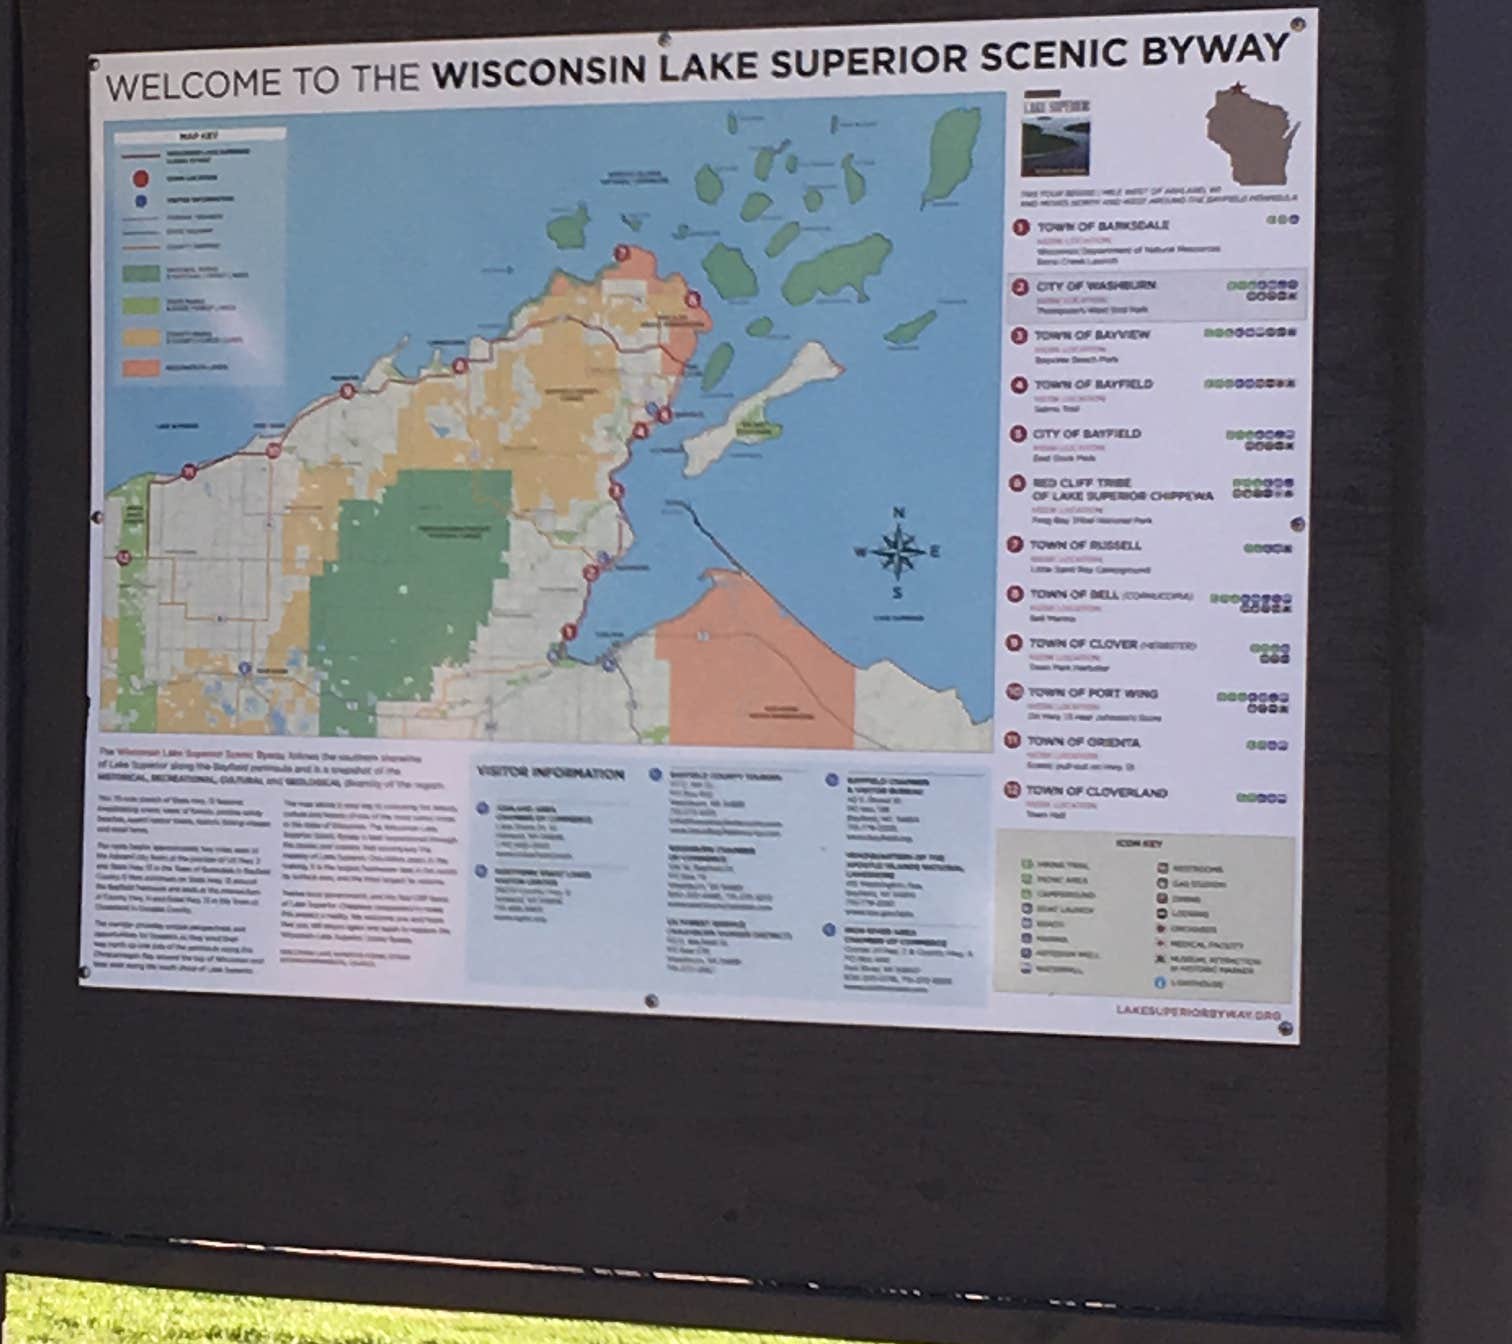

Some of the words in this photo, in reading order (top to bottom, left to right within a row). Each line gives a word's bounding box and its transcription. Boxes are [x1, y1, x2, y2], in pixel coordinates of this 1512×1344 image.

[106, 69, 282, 101] WELCOME
[293, 66, 339, 94] TO
[352, 62, 420, 92] THE
[432, 54, 644, 90] WISCONSIN
[661, 51, 757, 83] LAKE
[771, 42, 966, 78] SUPERIOR
[981, 37, 1128, 72] SCENIC
[1143, 32, 1290, 66] BYWAY
[1038, 221, 1075, 232] TOWN
[1078, 221, 1096, 231] OF
[1098, 219, 1170, 231] BARKSDALE
[1037, 281, 1065, 292] CITY
[1067, 280, 1084, 291] OF
[1086, 280, 1157, 291] WASHBURN
[1034, 330, 1071, 340] TOWN
[1074, 329, 1092, 340] OF
[1095, 329, 1151, 340] BAYVIEW
[1034, 380, 1072, 390] TOWN
[1074, 379, 1092, 390] OF
[1095, 378, 1154, 389] BAYFIELD
[1033, 428, 1061, 438] CITY
[1063, 428, 1080, 438] OF
[1083, 428, 1142, 439] BAYFIELD
[1033, 478, 1057, 488] RED
[1060, 478, 1093, 488] CLIFF
[1097, 477, 1131, 488] TRIBE
[1032, 491, 1049, 501] OF
[1052, 491, 1084, 501] LAKE
[1087, 491, 1146, 501] SUPERIOR
[1150, 491, 1215, 501] CHIPPEWA
[893, 506, 905, 518] N
[929, 544, 941, 558] E
[1030, 540, 1067, 550] TOWN
[1069, 540, 1087, 550] OF
[1089, 540, 1142, 551] RUSSELL
[892, 586, 903, 599] S
[1030, 589, 1067, 599] TOWN
[1069, 589, 1087, 599] OF
[1090, 589, 1120, 600] BELL
[1030, 638, 1066, 649] TOWN
[1069, 638, 1085, 649] OF
[1089, 638, 1138, 649] CLOVER
[1029, 687, 1066, 697] TOWN
[1068, 688, 1085, 698] OF
[1089, 688, 1120, 698] PORT
[1125, 689, 1159, 699] WING
[1028, 736, 1064, 746] TOWN
[1067, 736, 1084, 747] OF
[1087, 736, 1141, 748] ORIENTA
[476, 765, 529, 778] VISITOR
[531, 766, 625, 781] INFORMATION
[1026, 785, 1064, 795] TOWN
[1066, 785, 1083, 796] OF
[1086, 786, 1168, 798] CLOVERLAND
[1116, 1005, 1282, 1021] LAKESUPERIORBYWAY.ORG
